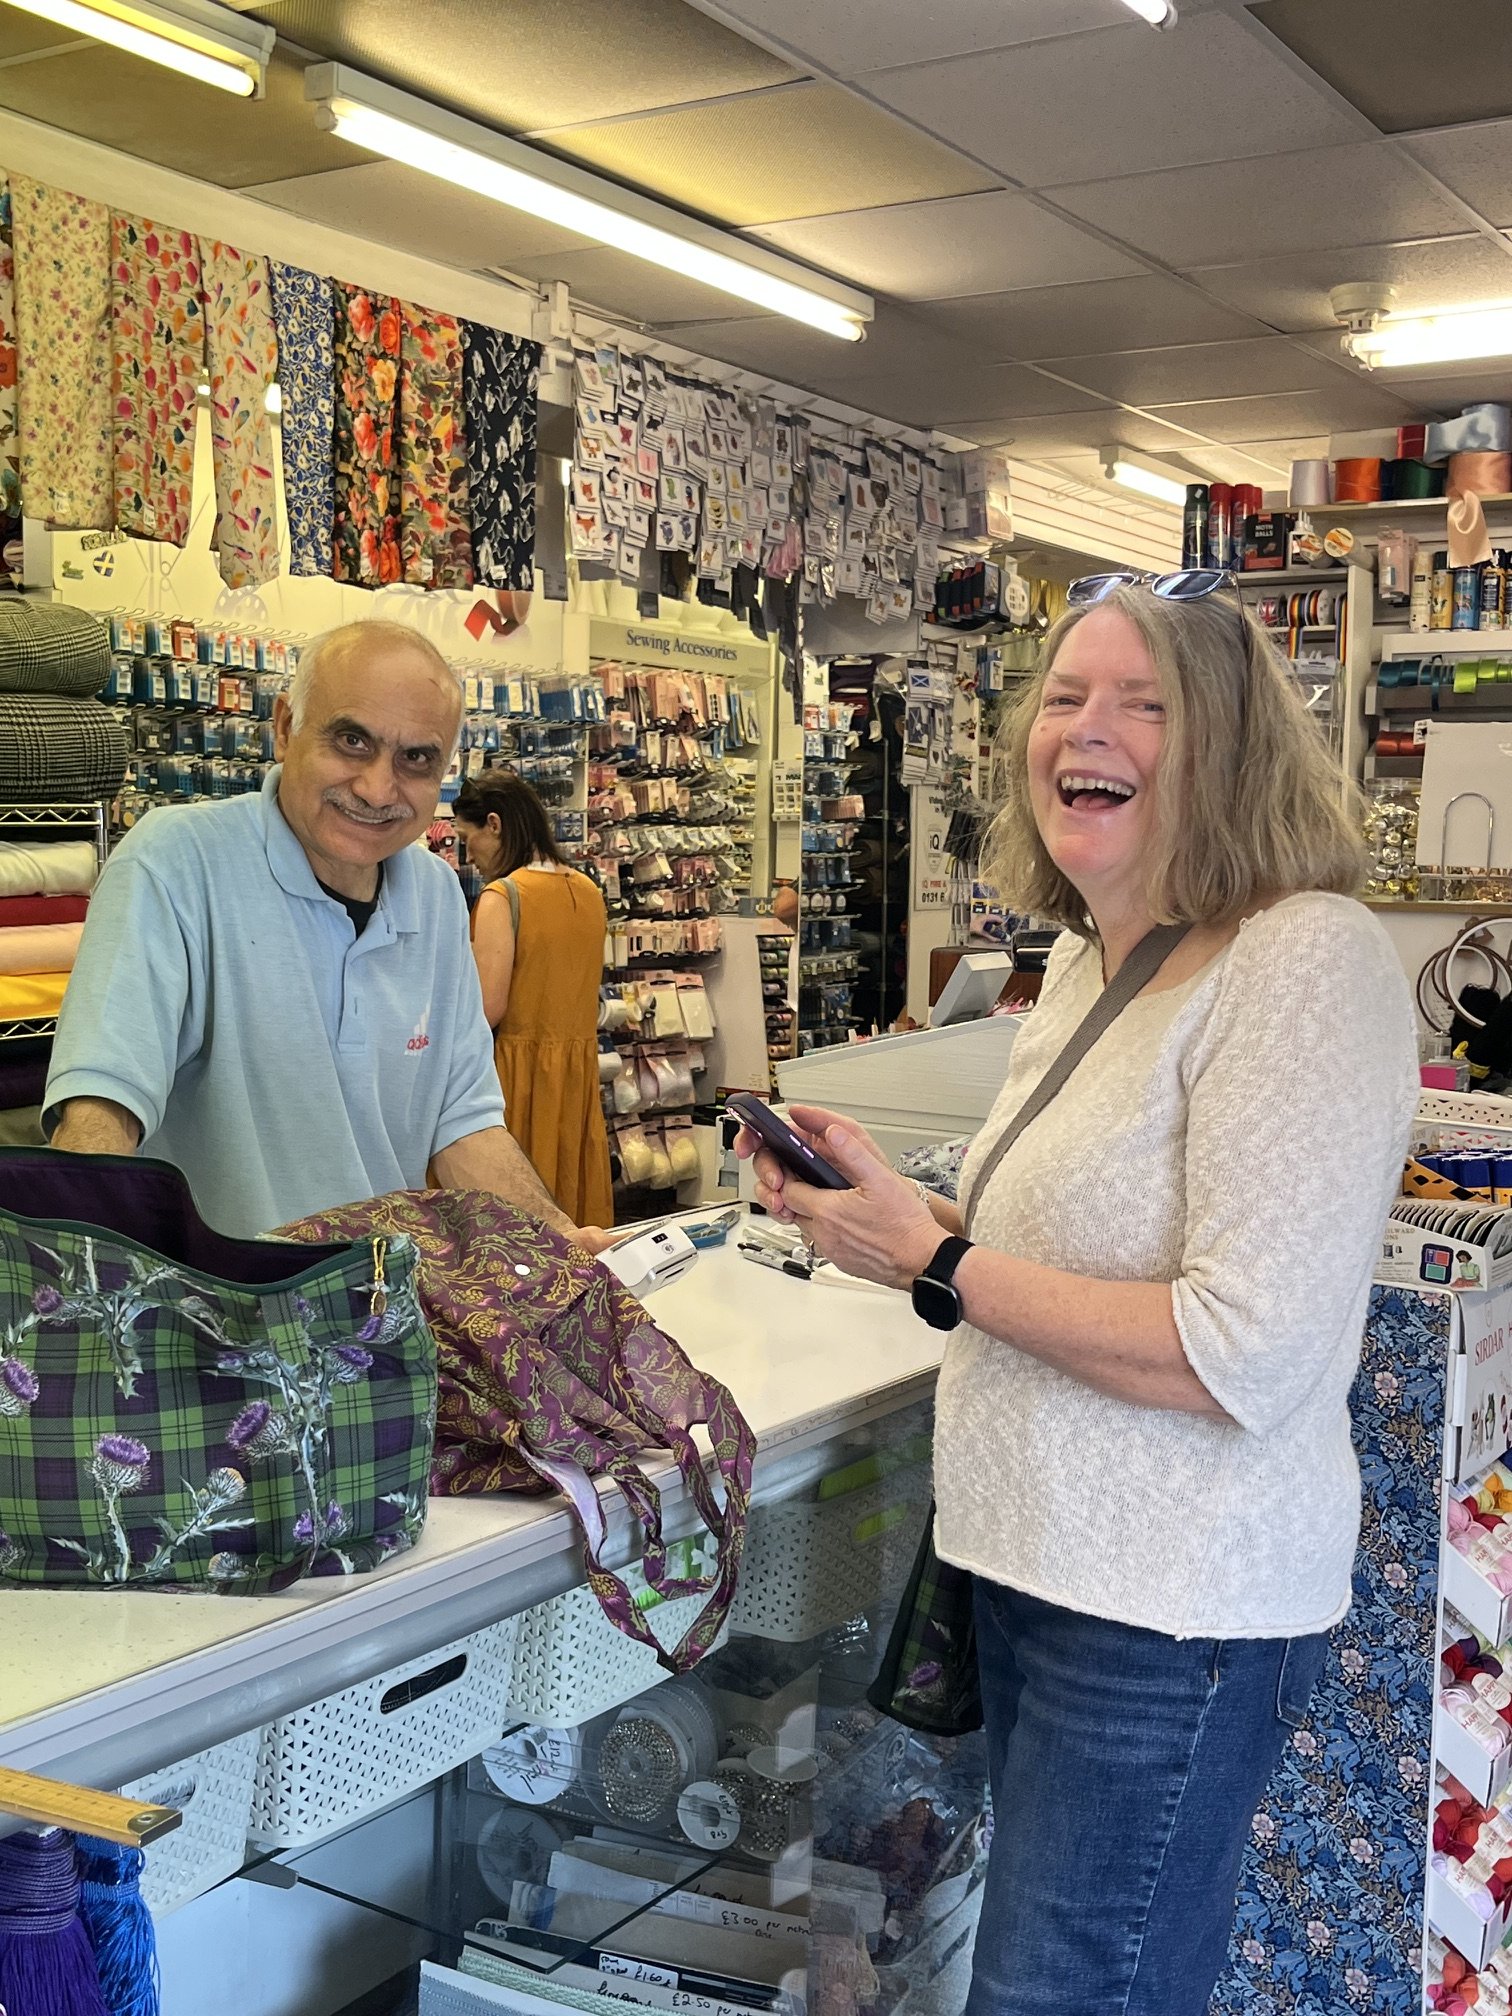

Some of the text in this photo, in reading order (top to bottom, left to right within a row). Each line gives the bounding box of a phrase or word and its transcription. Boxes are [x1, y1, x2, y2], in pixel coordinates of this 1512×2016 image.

[626, 628, 738, 660] Sewing Accessories
[921, 892, 938, 903] 0131
[1385, 1227, 1416, 1235] ILWARD
[1475, 1328, 1504, 1366] SIRDAR
[672, 1992, 710, 2009] £2.50
